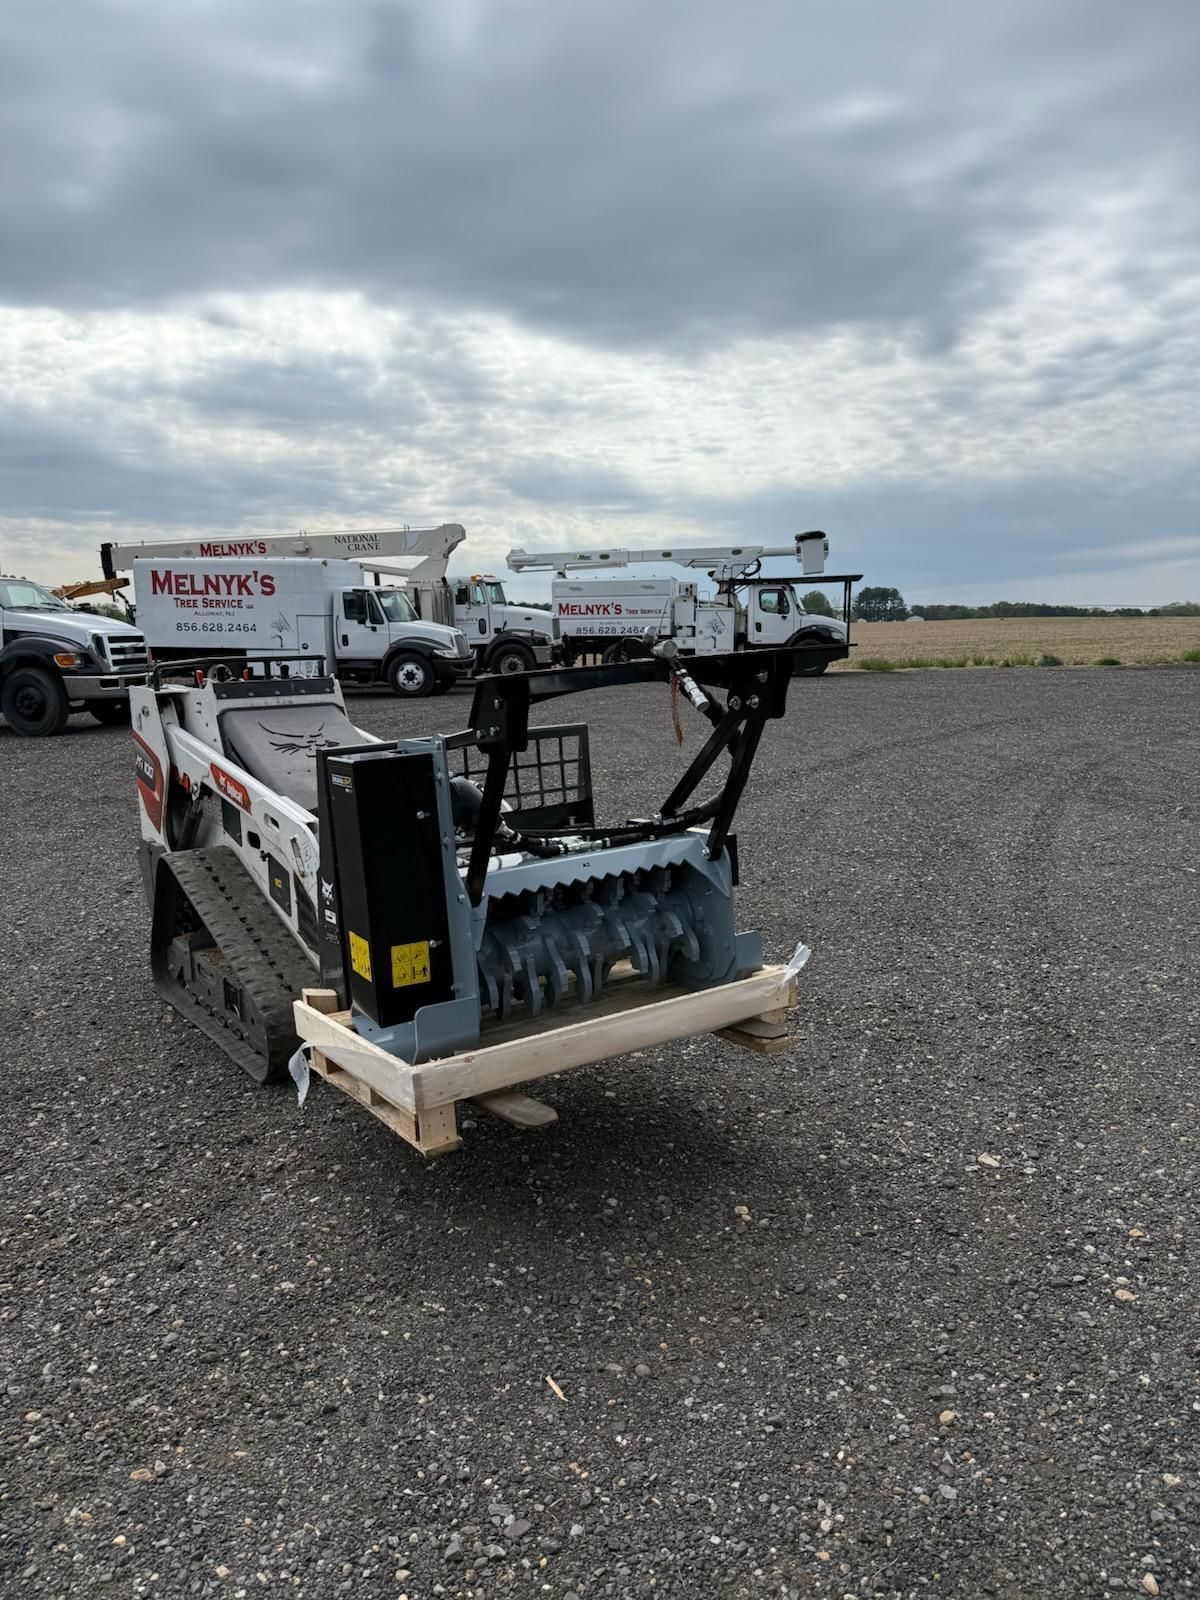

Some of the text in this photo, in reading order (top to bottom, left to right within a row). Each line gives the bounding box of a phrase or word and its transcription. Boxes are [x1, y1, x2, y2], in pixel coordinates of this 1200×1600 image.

[334, 534, 380, 544] NATIONAL
[199, 541, 267, 557] MELNYK'S
[347, 542, 380, 552] CRANE
[150, 569, 276, 596] MELNYK'S
[173, 597, 199, 609] TREE
[202, 597, 243, 609] SERVICE
[558, 602, 622, 616] MELNYK'S
[176, 622, 257, 632] 856.628.2464
